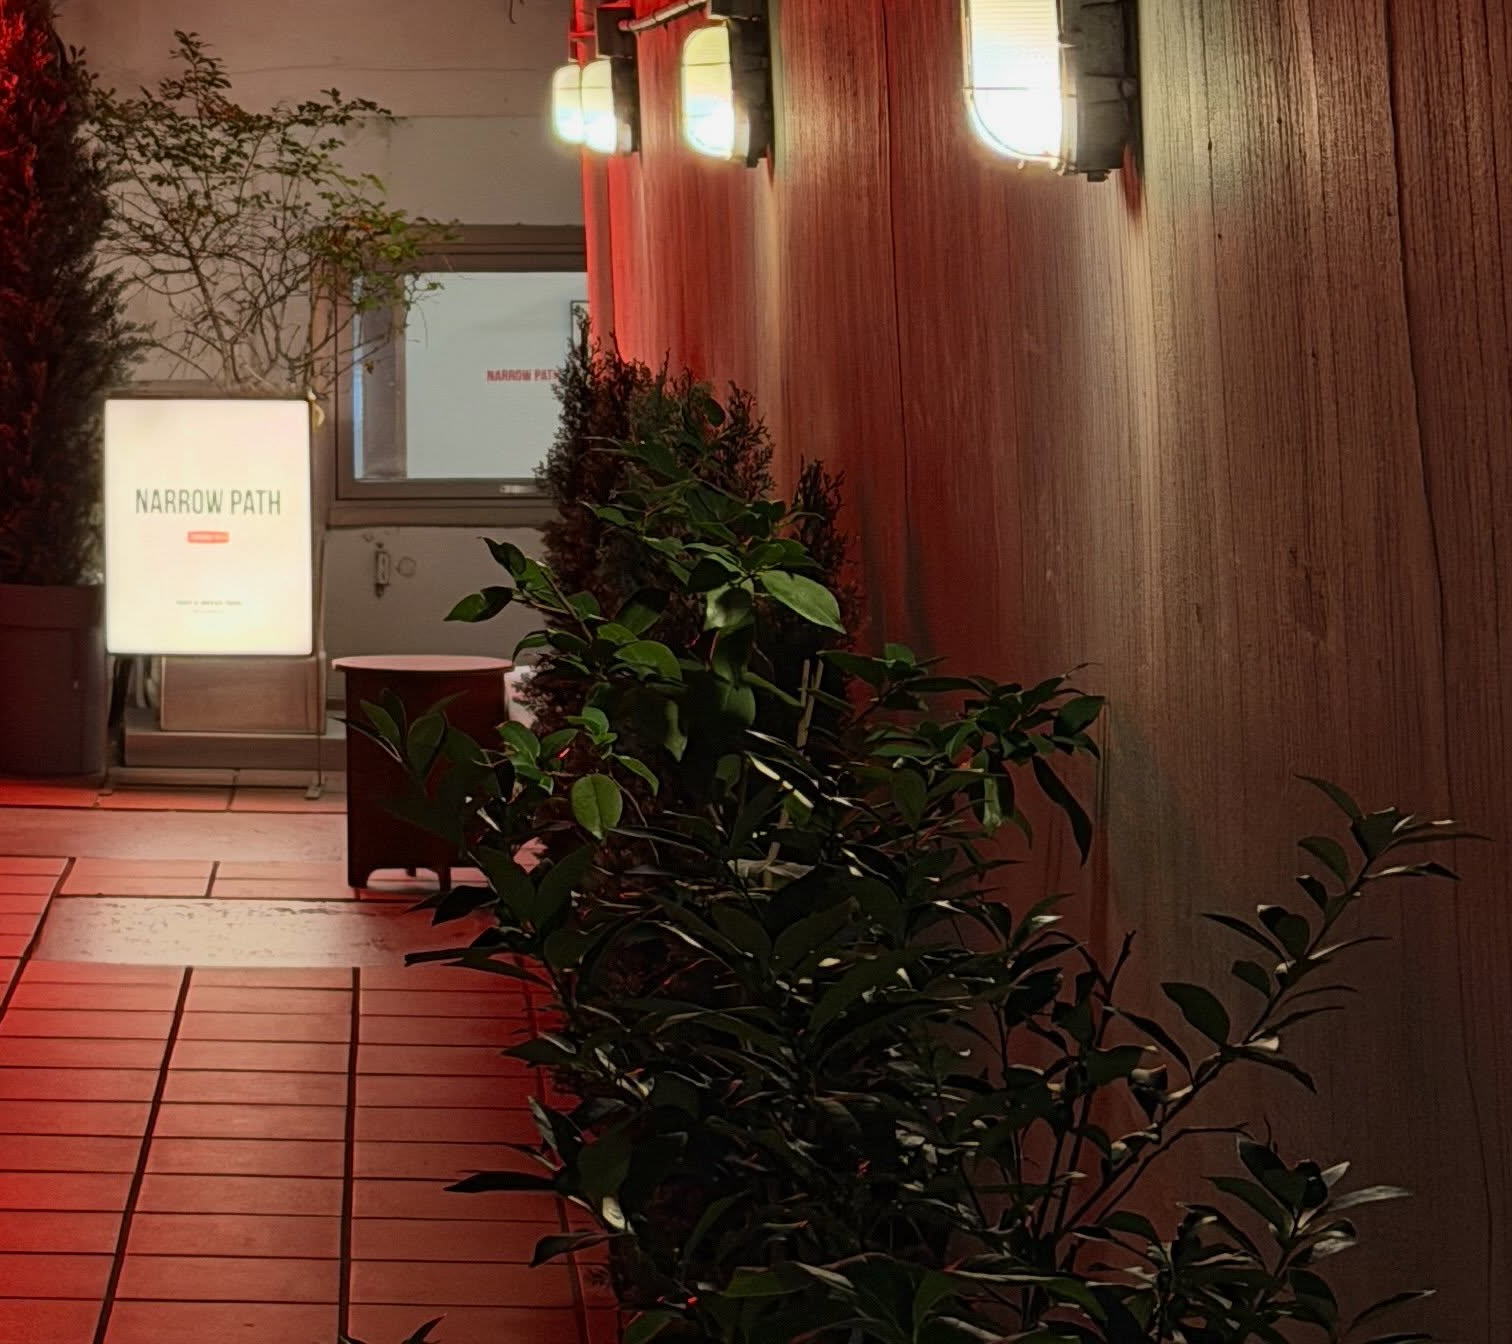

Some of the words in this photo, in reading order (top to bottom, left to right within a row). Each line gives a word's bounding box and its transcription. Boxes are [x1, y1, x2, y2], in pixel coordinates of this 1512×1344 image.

[487, 369, 531, 381] NARROW
[135, 488, 223, 514] NARROW
[231, 489, 281, 515] PATH
